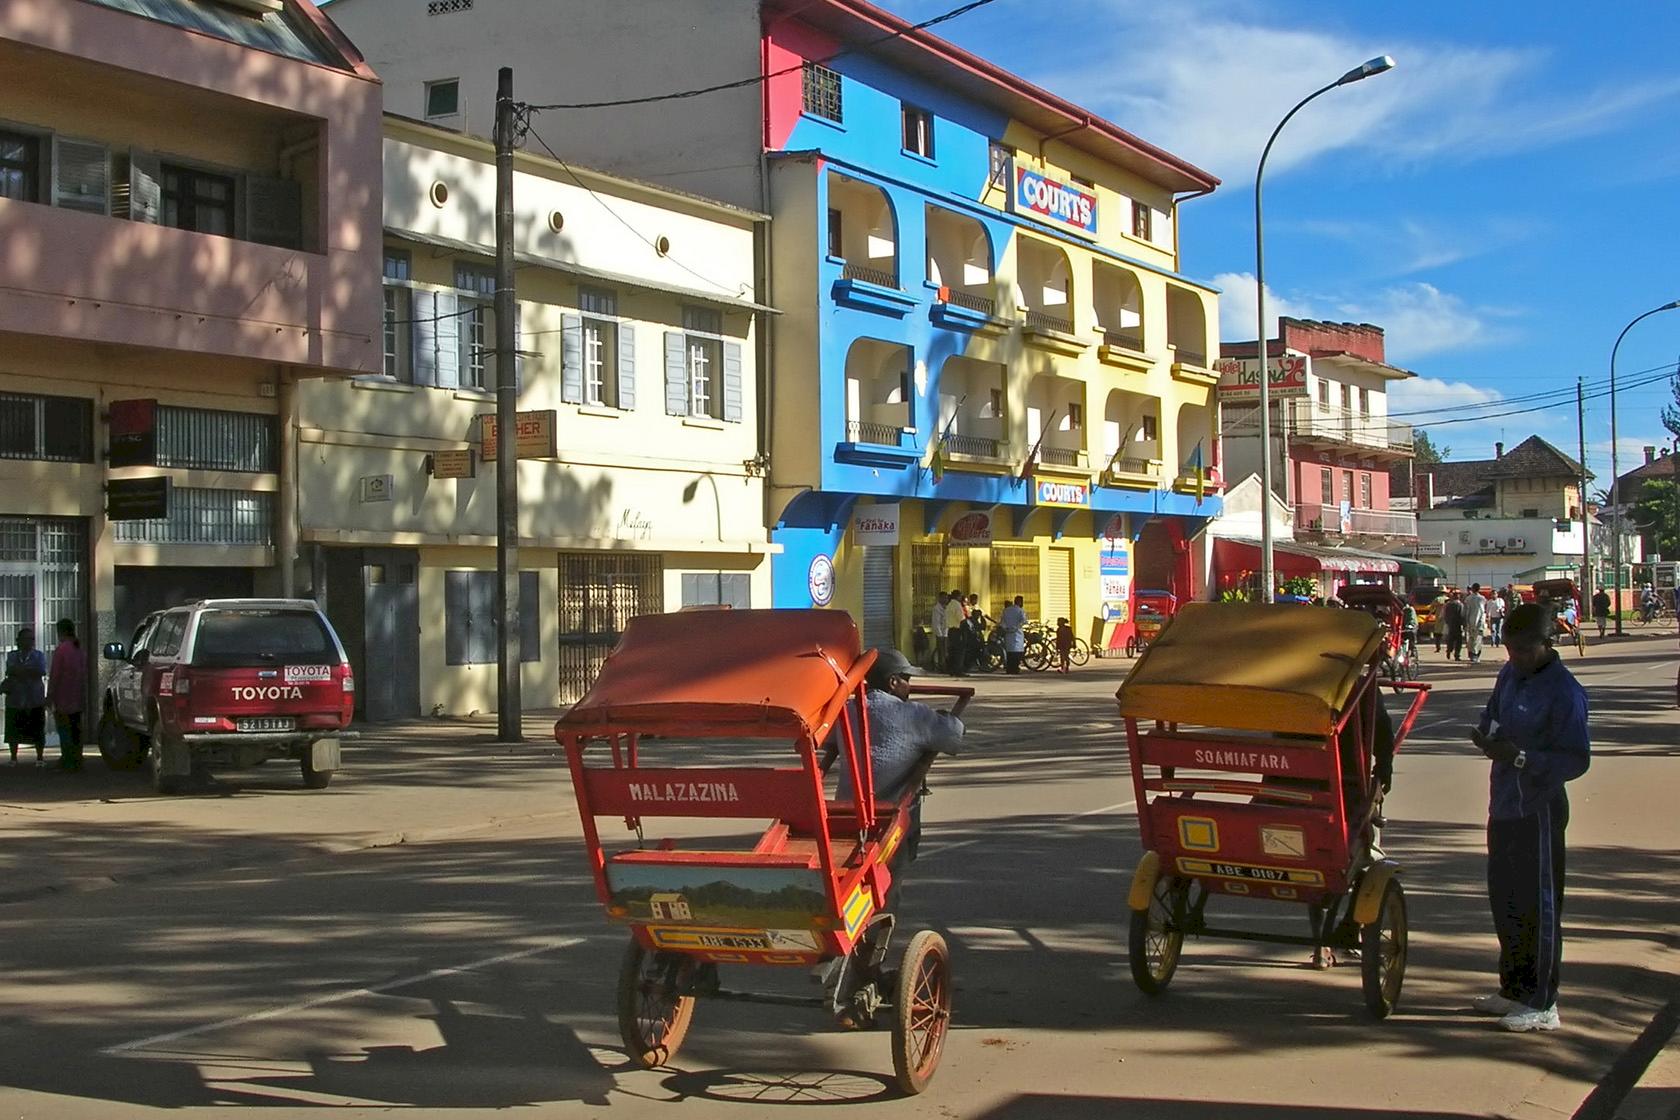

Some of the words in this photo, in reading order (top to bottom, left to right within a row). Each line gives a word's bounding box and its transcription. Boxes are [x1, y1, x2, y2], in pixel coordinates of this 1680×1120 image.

[1023, 177, 1092, 226] COURTS
[1043, 482, 1083, 503] COURTS
[285, 666, 330, 676] TOYOTA
[232, 687, 303, 700] TOYOTA
[1195, 750, 1289, 769] SOAMIAFARA
[629, 783, 739, 801] MALAZAZINA
[1216, 864, 1244, 876] ABE
